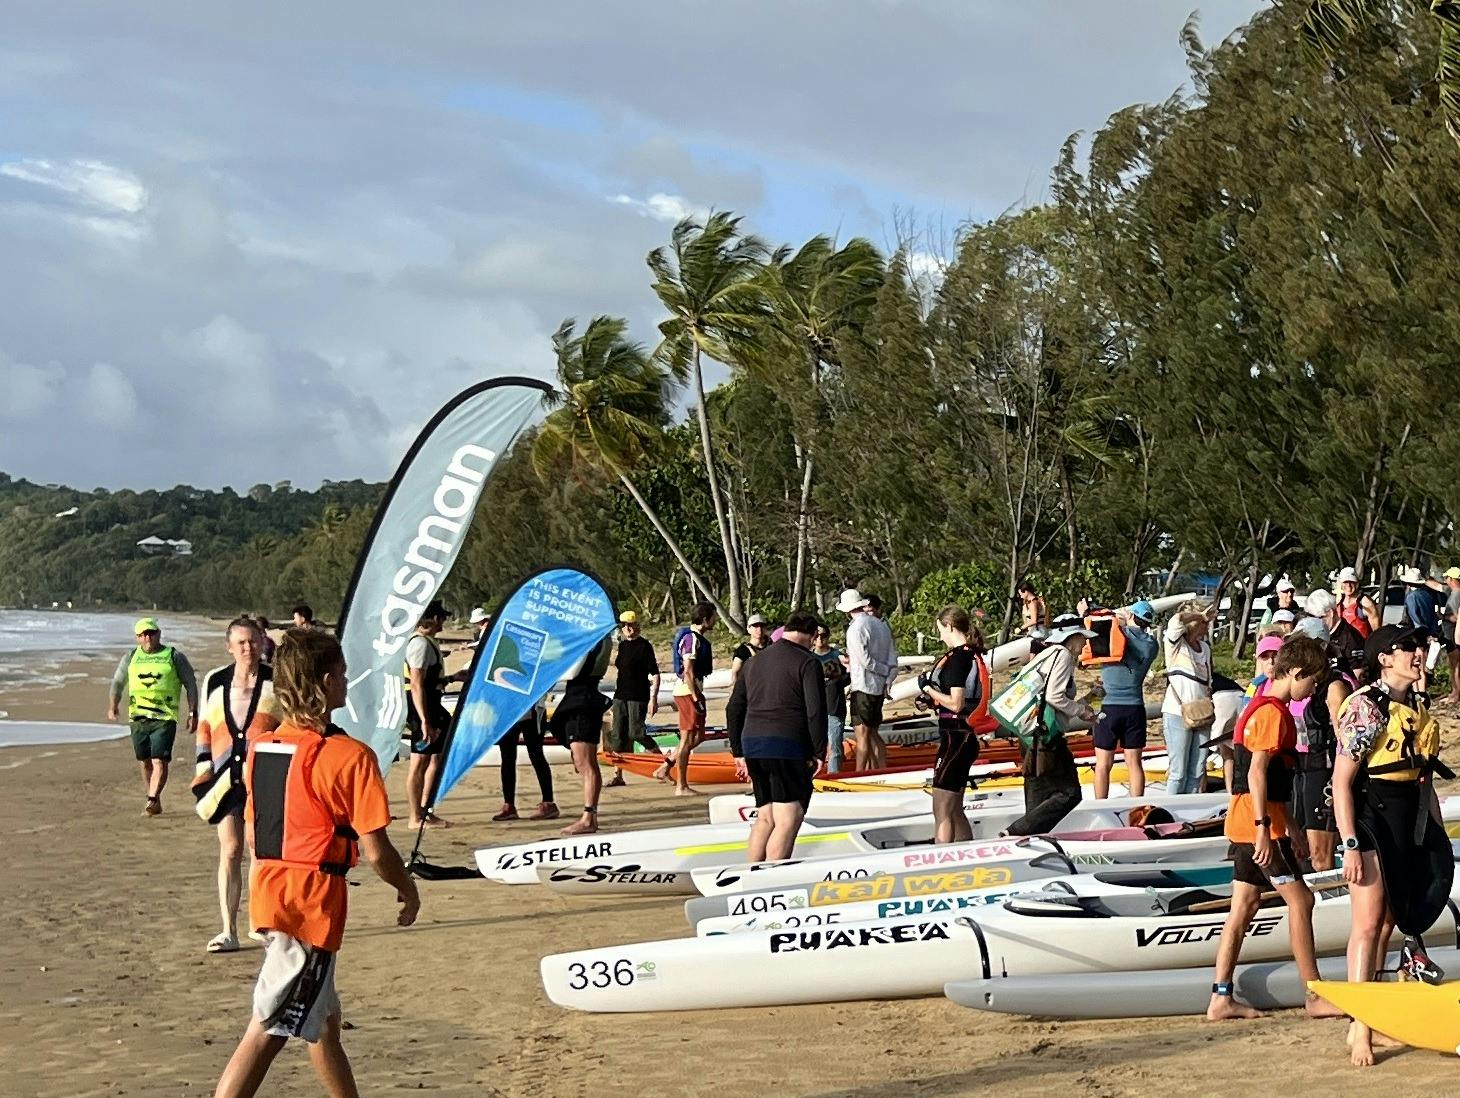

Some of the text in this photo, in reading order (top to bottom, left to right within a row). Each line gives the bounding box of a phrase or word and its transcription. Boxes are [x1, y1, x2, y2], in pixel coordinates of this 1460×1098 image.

[372, 443, 496, 657] tasman
[529, 589, 600, 618] IS PROUDLY
[533, 579, 602, 608] THIS EVENT
[521, 611, 539, 621] BY
[525, 601, 596, 630] SUPPORTED
[522, 842, 612, 866] STELLAR
[578, 864, 676, 884] STELLAR
[732, 895, 787, 916] 495
[878, 891, 1019, 918] PUAKE
[770, 921, 951, 953] PUAKEA
[567, 959, 634, 990] 336
